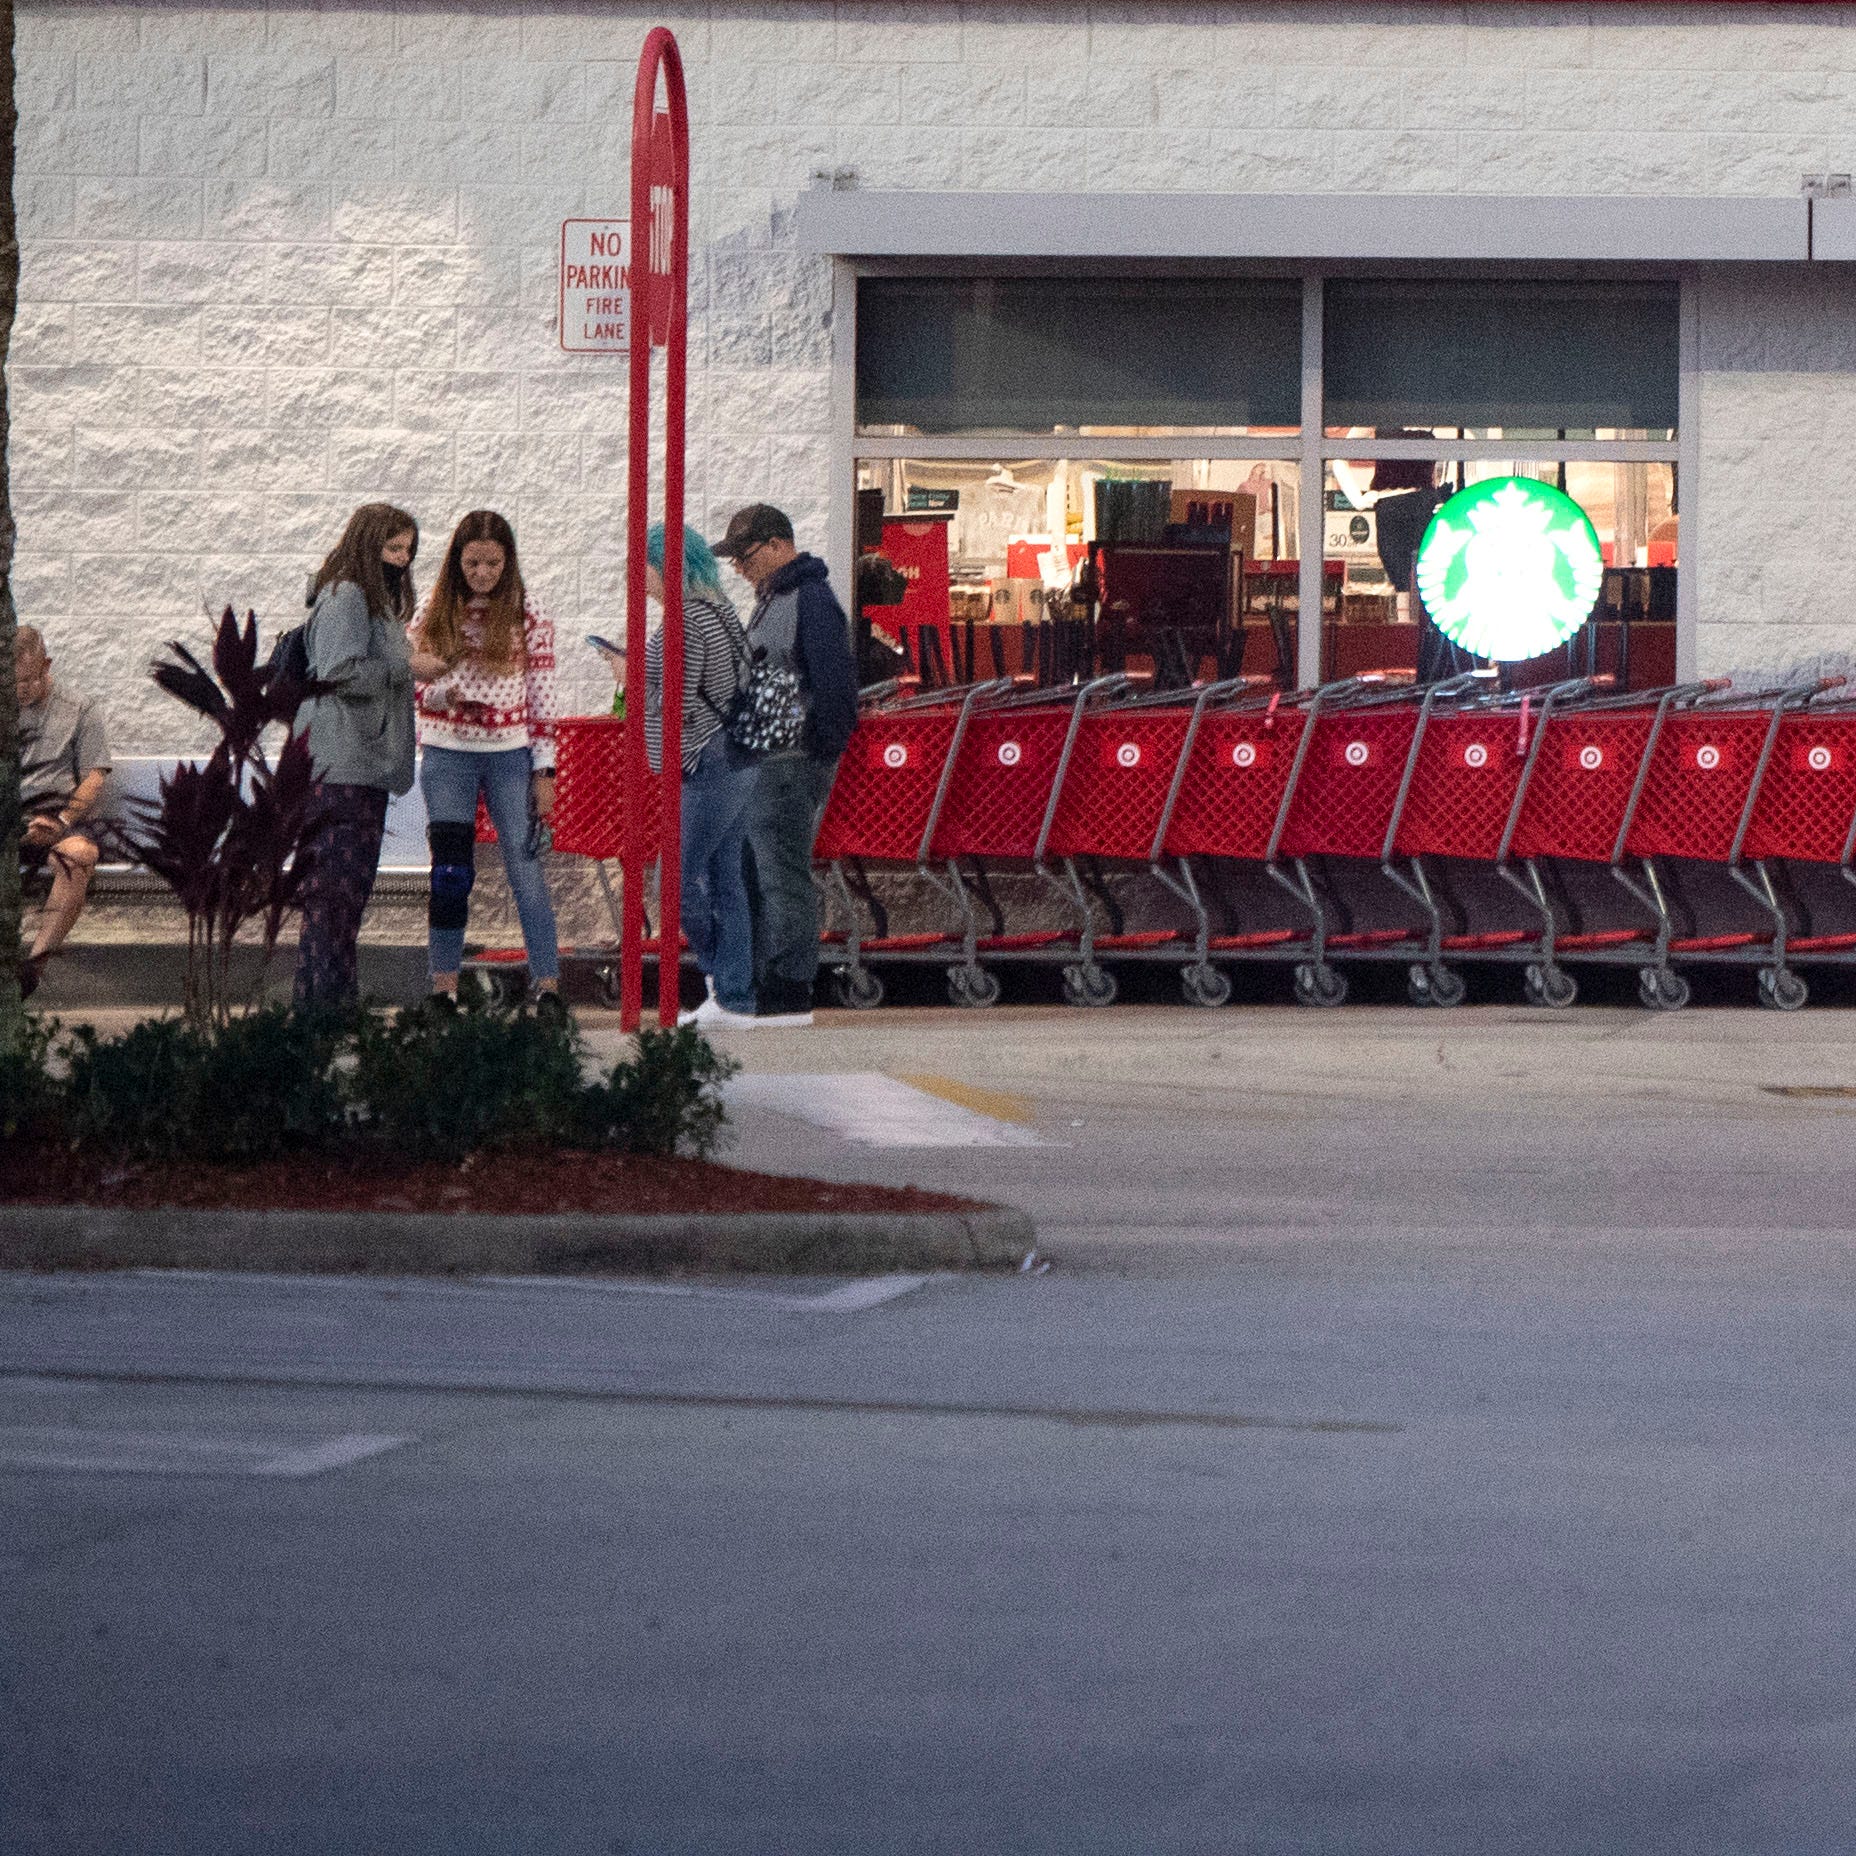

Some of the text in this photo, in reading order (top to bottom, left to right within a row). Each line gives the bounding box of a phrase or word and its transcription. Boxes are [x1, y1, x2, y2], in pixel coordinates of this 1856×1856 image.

[590, 232, 621, 256] NO
[567, 264, 631, 289] PARKIN
[586, 297, 623, 314] FIRE
[584, 323, 624, 339] LANE
